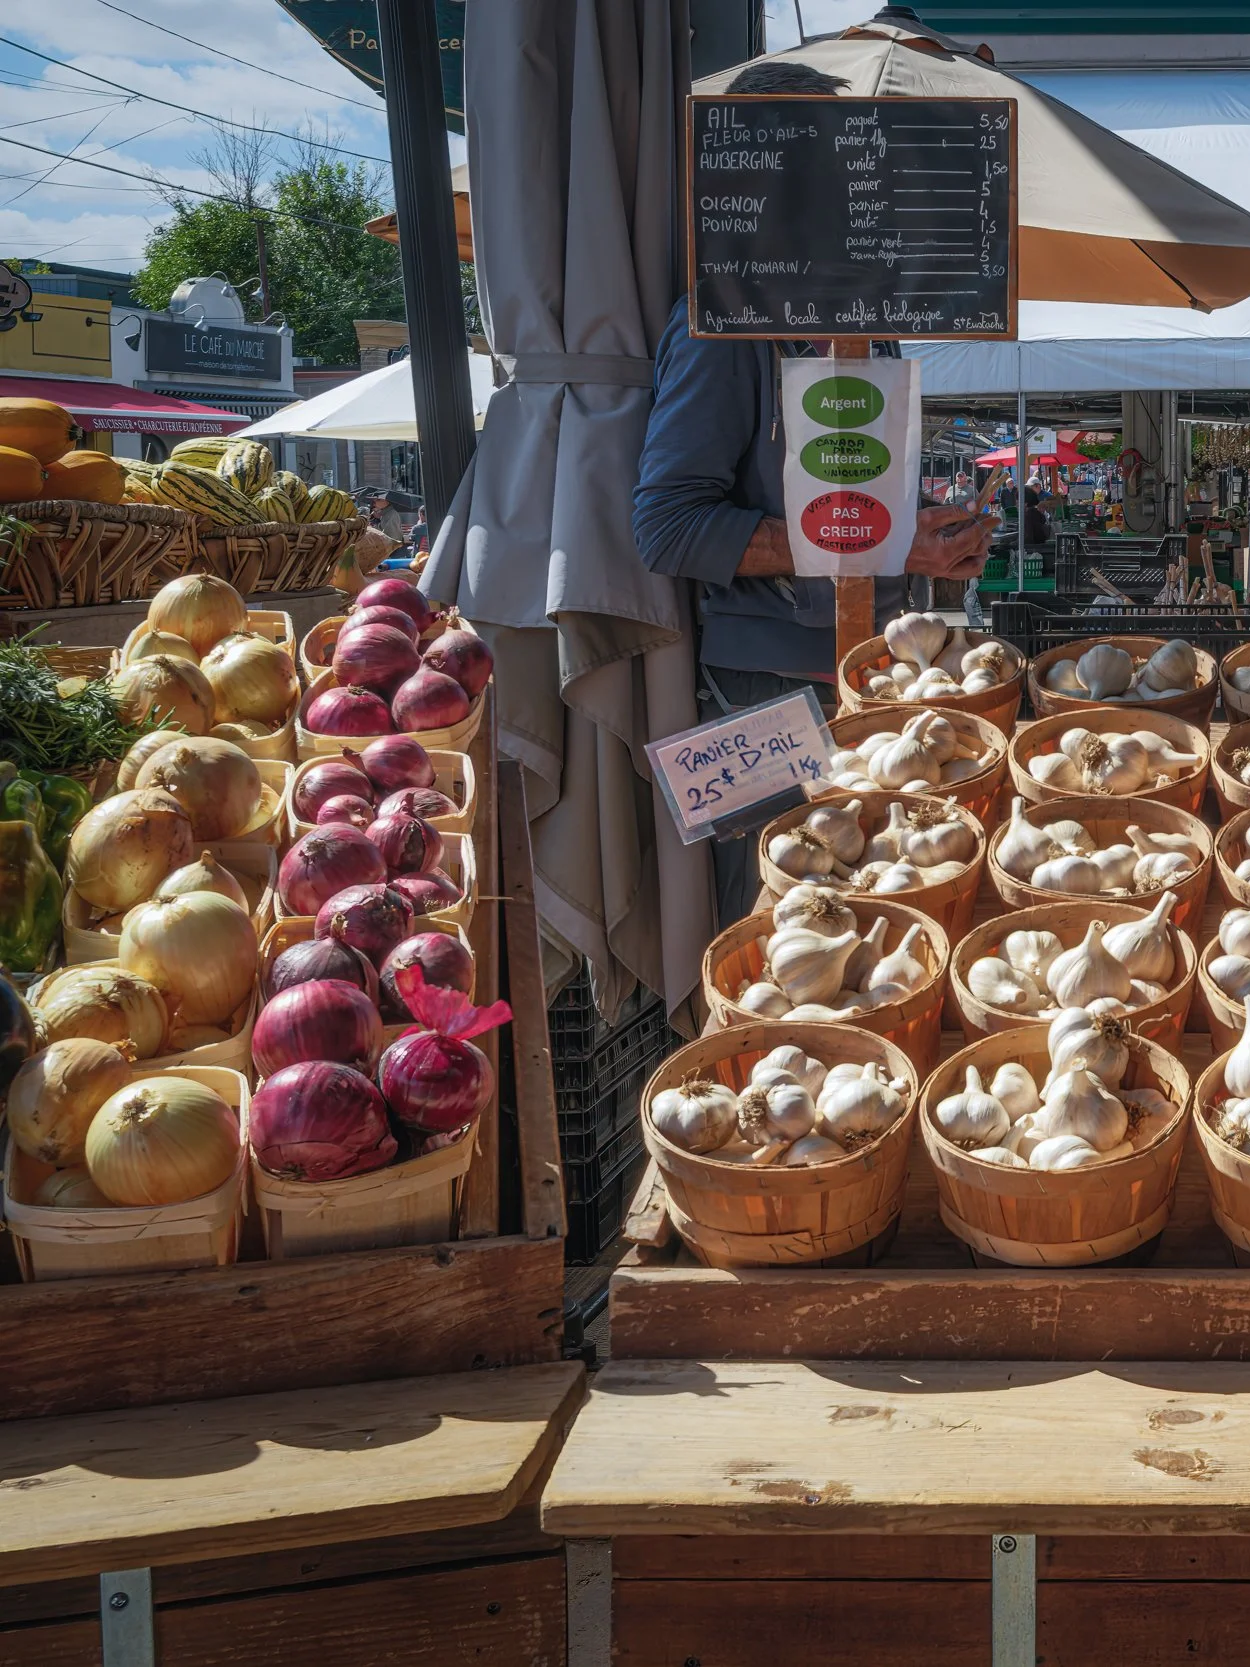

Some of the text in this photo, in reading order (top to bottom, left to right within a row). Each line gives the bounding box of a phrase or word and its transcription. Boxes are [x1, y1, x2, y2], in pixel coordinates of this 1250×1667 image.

[708, 106, 745, 128] AIL
[980, 114, 1008, 131] 5,50
[702, 129, 751, 150] FLEUR
[834, 132, 868, 152] panier
[980, 135, 997, 150] 25
[700, 150, 1008, 179] AUBERGINE unité 1,50
[848, 174, 991, 198] panier 5
[700, 196, 988, 220] OIGNON panier 4
[702, 215, 758, 232] POIVRON
[981, 219, 997, 235] 1,5
[846, 236, 878, 250] panier
[981, 236, 990, 250] 4
[980, 250, 990, 262] 5
[700, 260, 739, 274] THYM
[752, 260, 798, 274] ROMARIN
[982, 264, 1006, 279] 3,50
[705, 304, 774, 332] Agriculture
[784, 301, 822, 326] locale
[882, 300, 944, 332] biologique
[184, 334, 265, 360] LE CAFÉ DU MARCHÉ
[820, 396, 867, 411] Argent
[92, 418, 224, 434] SAUCISSIER CHARCUTERIE EUROPÉENNE
[815, 438, 866, 449] CANADA
[821, 452, 870, 464] Interac
[832, 507, 860, 519] PAS
[820, 526, 873, 538] CREDIT
[687, 767, 736, 812] 25$
